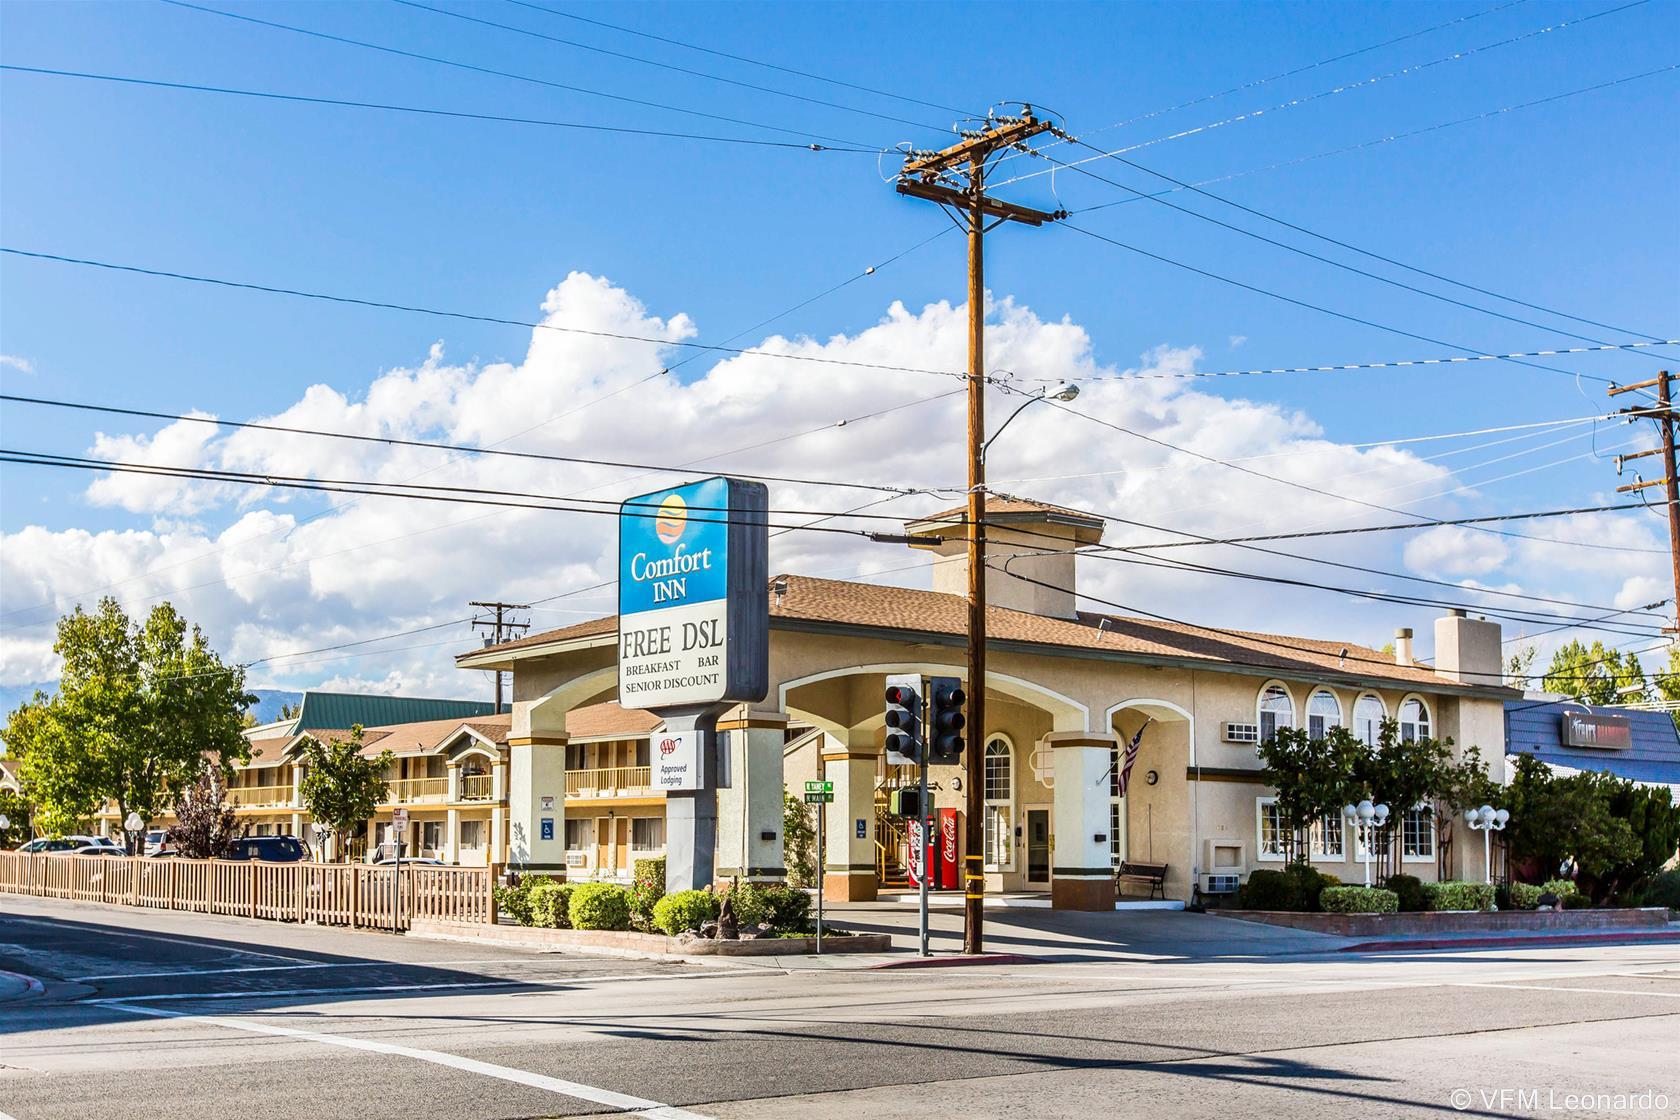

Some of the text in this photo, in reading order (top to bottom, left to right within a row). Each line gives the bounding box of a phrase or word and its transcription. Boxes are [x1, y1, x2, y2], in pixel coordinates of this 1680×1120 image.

[631, 543, 712, 582] Comfort
[653, 578, 687, 603] INN
[622, 619, 724, 659] FREE DSL
[626, 655, 719, 676] BREAKFAST BAR
[626, 673, 720, 693] SENIOR DISCOUNT
[660, 764, 688, 775] Approved
[660, 776, 683, 787] Lodging
